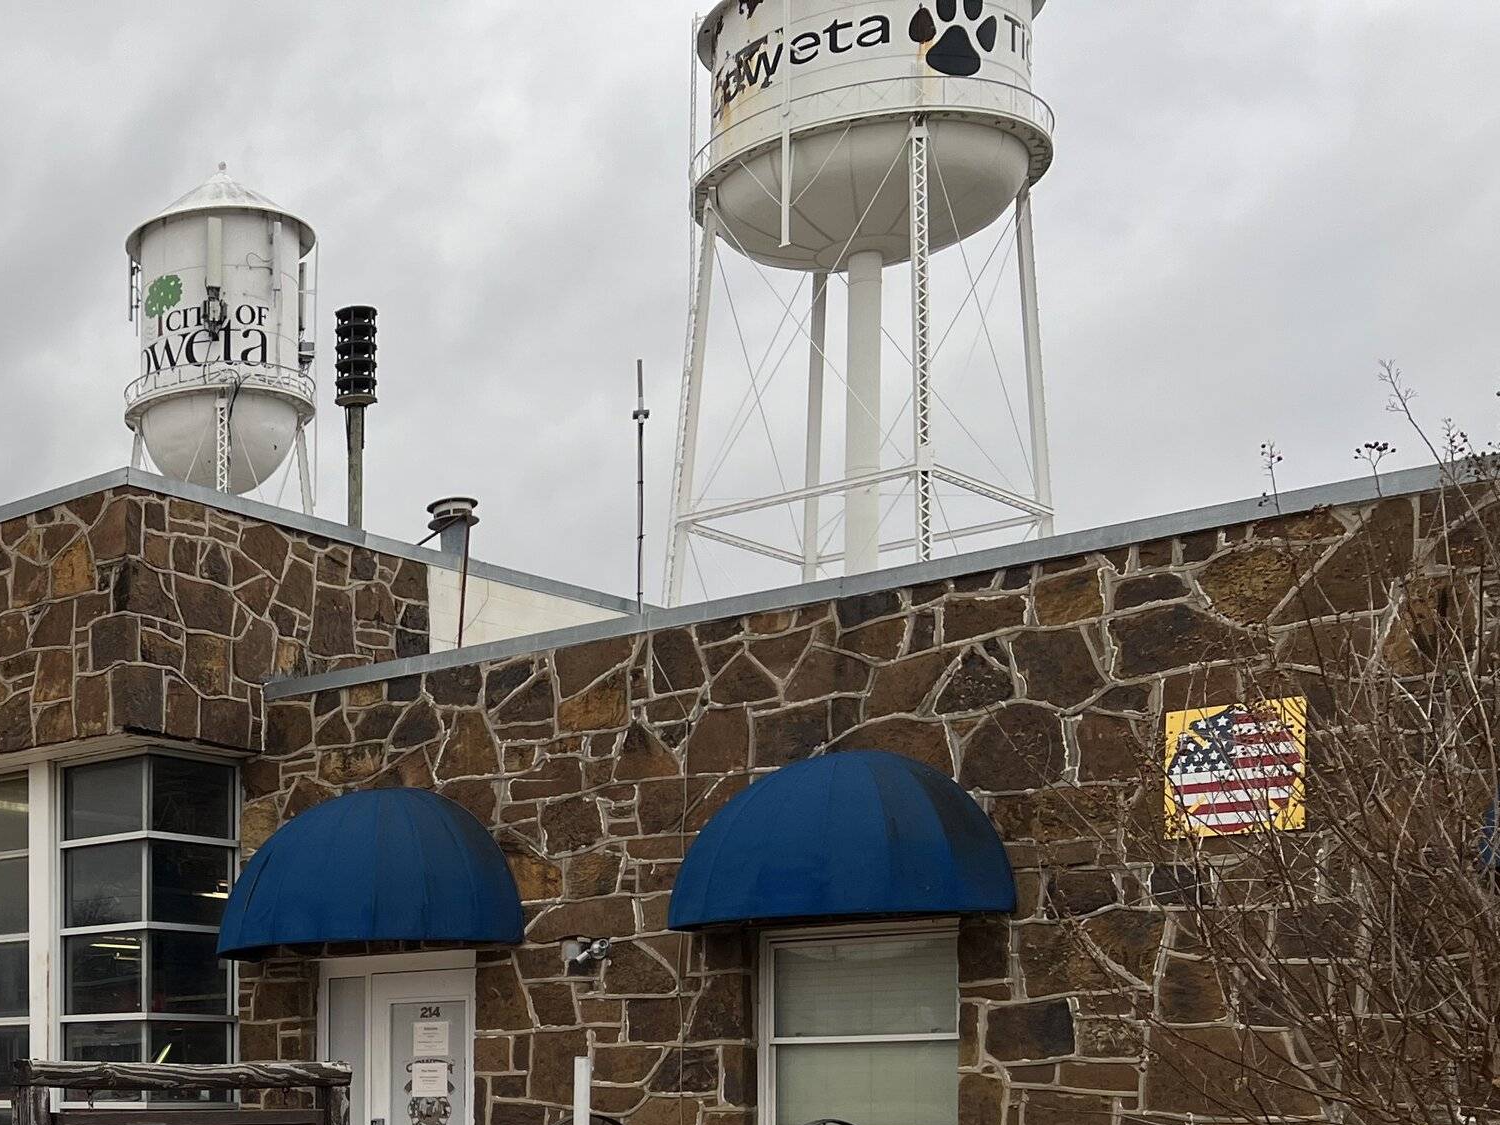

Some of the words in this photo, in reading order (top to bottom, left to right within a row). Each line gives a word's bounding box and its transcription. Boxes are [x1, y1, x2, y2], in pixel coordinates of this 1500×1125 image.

[165, 305, 210, 332] CIT
[235, 304, 270, 327] OF
[419, 1006, 441, 1019] 214
